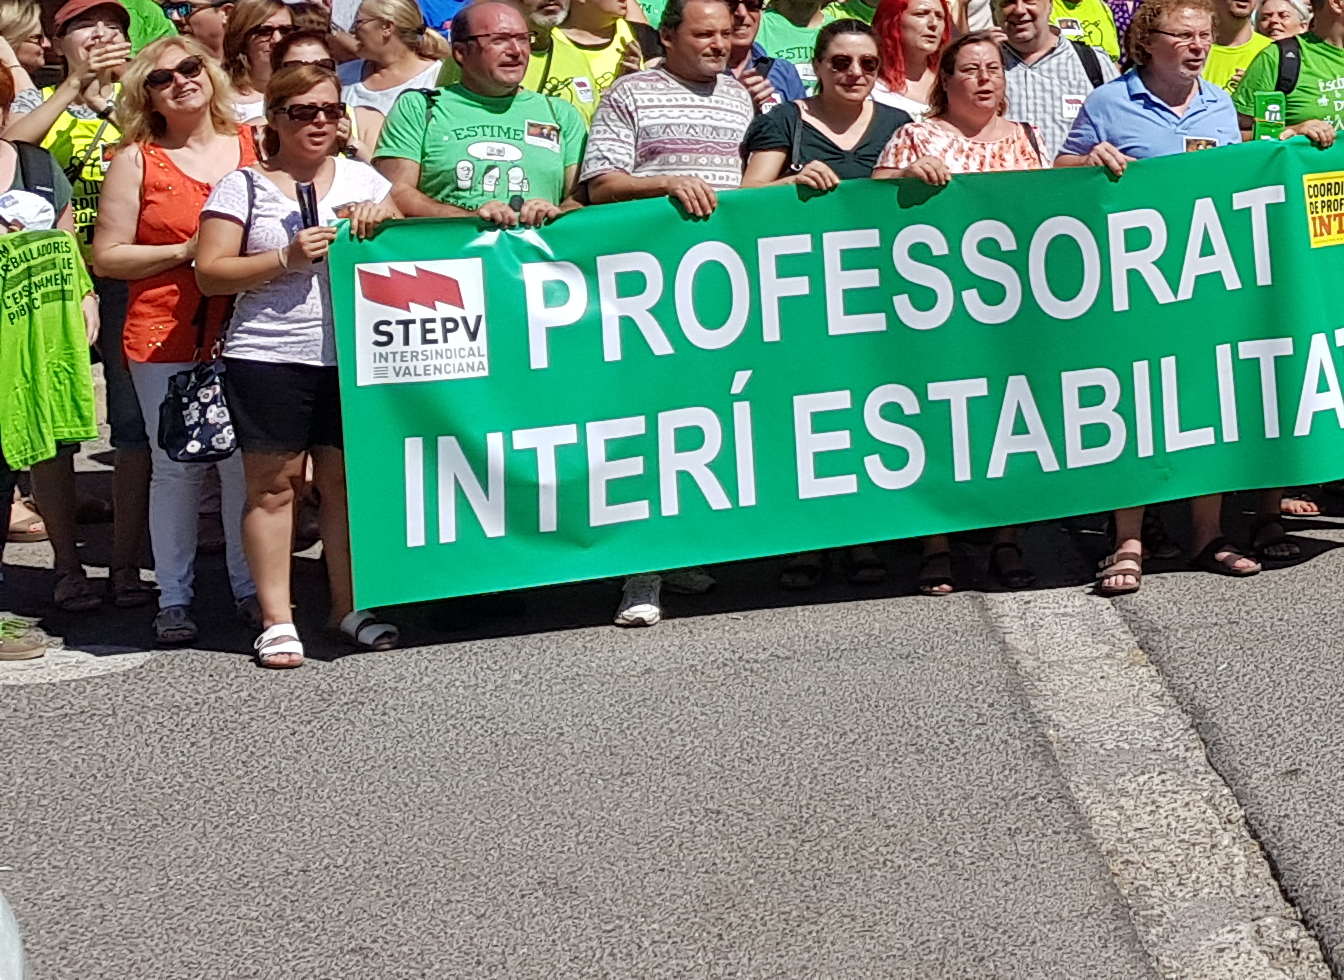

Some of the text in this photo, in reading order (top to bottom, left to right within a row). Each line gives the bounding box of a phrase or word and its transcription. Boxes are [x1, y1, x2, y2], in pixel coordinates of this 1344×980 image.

[1309, 200, 1319, 215] DE
[520, 185, 1286, 370] PROFESSORAT
[371, 314, 483, 348] STEPV
[372, 345, 486, 364] INTERSINDICAL
[392, 360, 486, 378] VALENCIANA
[404, 369, 757, 548] INTERÍ
